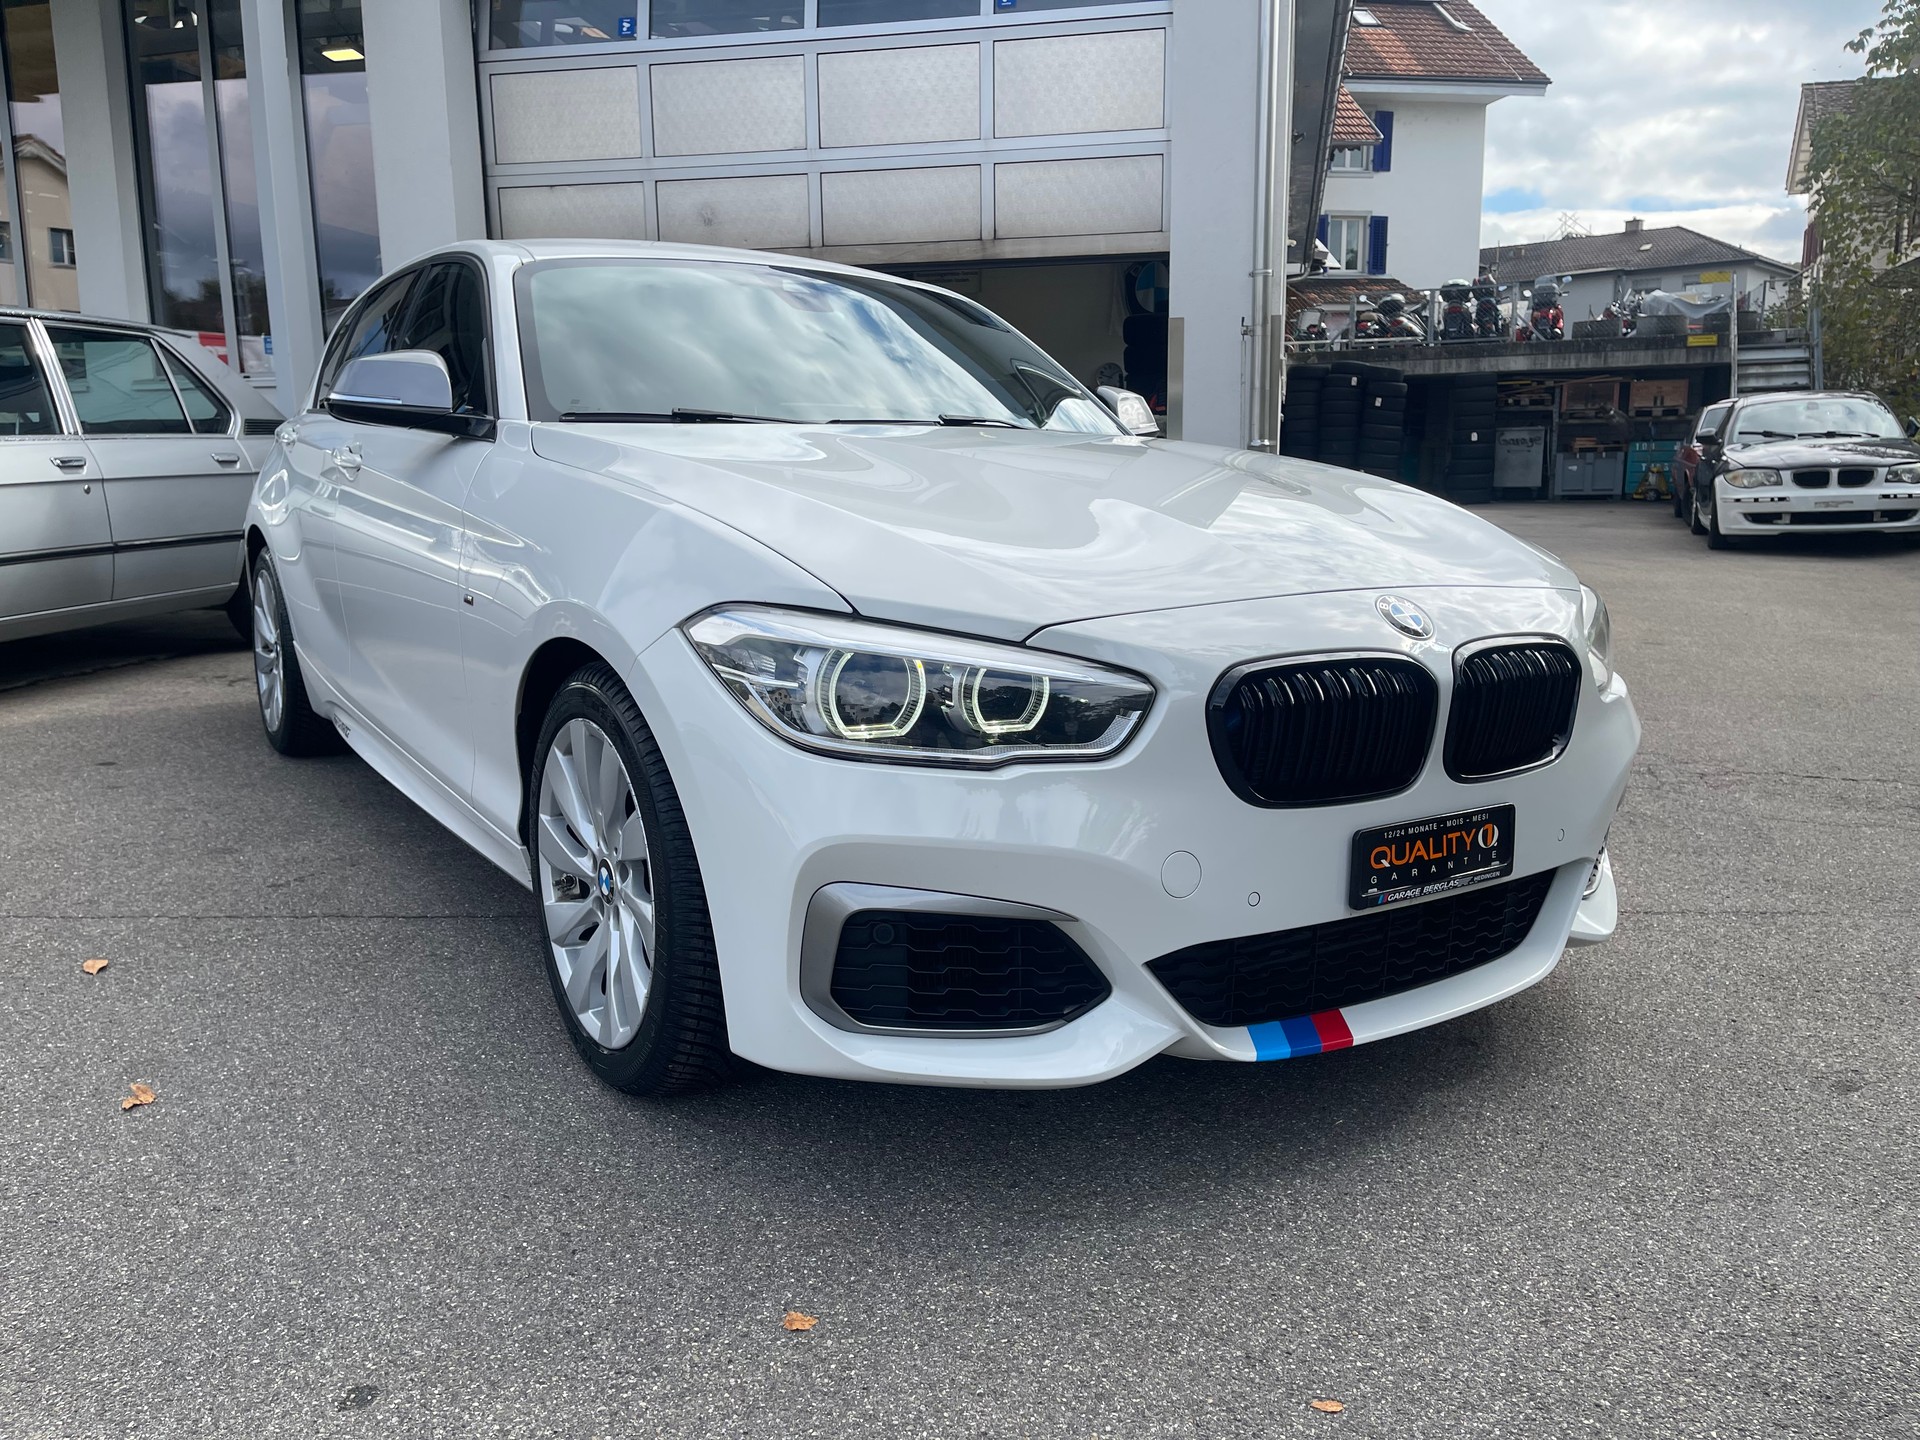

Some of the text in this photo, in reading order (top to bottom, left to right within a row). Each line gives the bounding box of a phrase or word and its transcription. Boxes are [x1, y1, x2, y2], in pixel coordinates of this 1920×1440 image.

[1384, 828, 1405, 839] 12/24
[1408, 823, 1438, 835] MONATE
[1446, 817, 1464, 827] MOIS
[1472, 813, 1489, 823] MESI
[1370, 829, 1476, 869] QUALITY
[1370, 850, 1497, 884] GARANTIE
[1387, 887, 1422, 902] GARAGE
[1473, 871, 1501, 882] HEDINGEN
